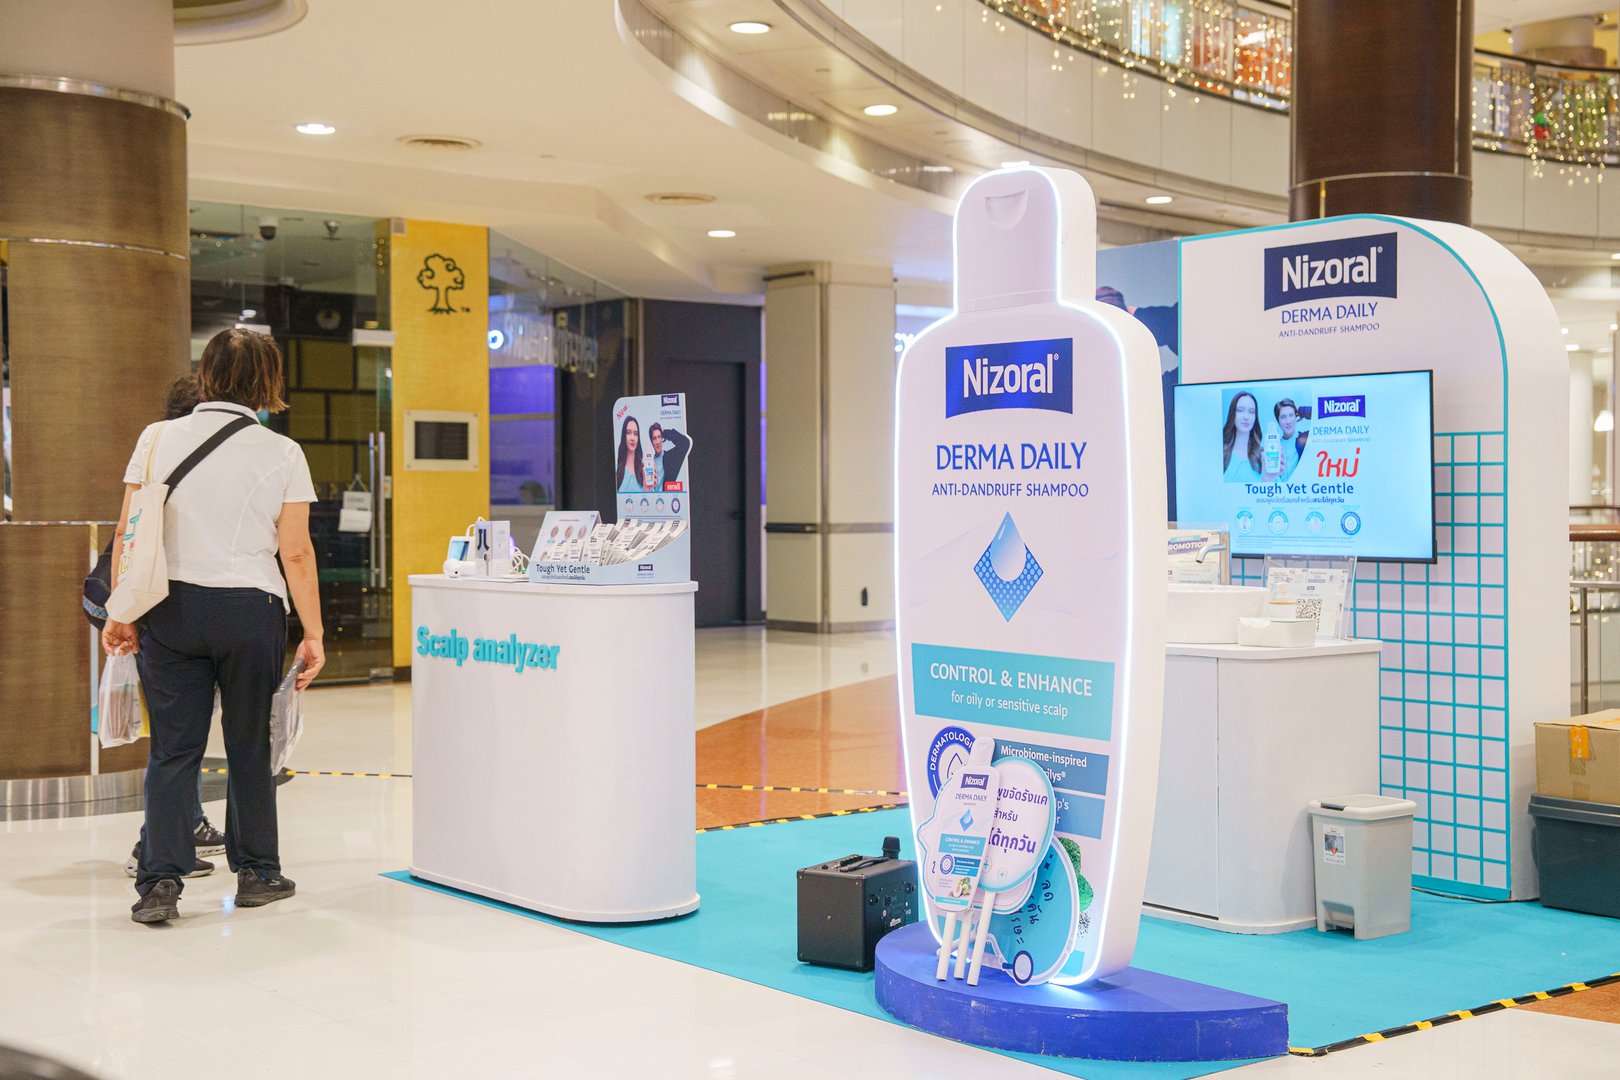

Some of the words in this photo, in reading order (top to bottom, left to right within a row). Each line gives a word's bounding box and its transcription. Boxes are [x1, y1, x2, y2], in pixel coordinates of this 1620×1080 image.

[1280, 306, 1333, 325] DERMA
[1336, 301, 1379, 320] DAILY
[1278, 326, 1338, 338] ANTI-DANDRUFF
[1339, 322, 1380, 333] SHAMPOO
[1312, 427, 1344, 436] DERMA
[1345, 424, 1370, 435] DAILY
[936, 443, 1016, 470] DERMA
[1020, 441, 1088, 470] DAILY
[1316, 447, 1361, 478] ใหม่
[931, 482, 1022, 496] ANTI-DANDRUFF
[1026, 482, 1089, 497] SHAMPOO
[1245, 483, 1282, 498] Tough
[1286, 483, 1308, 494] Yet
[1311, 482, 1354, 494] Gentle
[536, 564, 555, 574] Tough
[556, 565, 567, 573] Yet
[569, 564, 590, 574] Gentle
[416, 625, 469, 667] Scalp
[473, 633, 561, 673] analyzer
[930, 662, 997, 686] CONTROL
[1000, 671, 1013, 688] &
[1017, 672, 1093, 697] ENHANCE
[951, 690, 964, 704] for
[966, 693, 983, 709] oily
[985, 697, 995, 707] or
[997, 698, 1041, 714] sensitive
[1043, 704, 1068, 719] scalp
[1000, 744, 1087, 768] Microbiome-inspired
